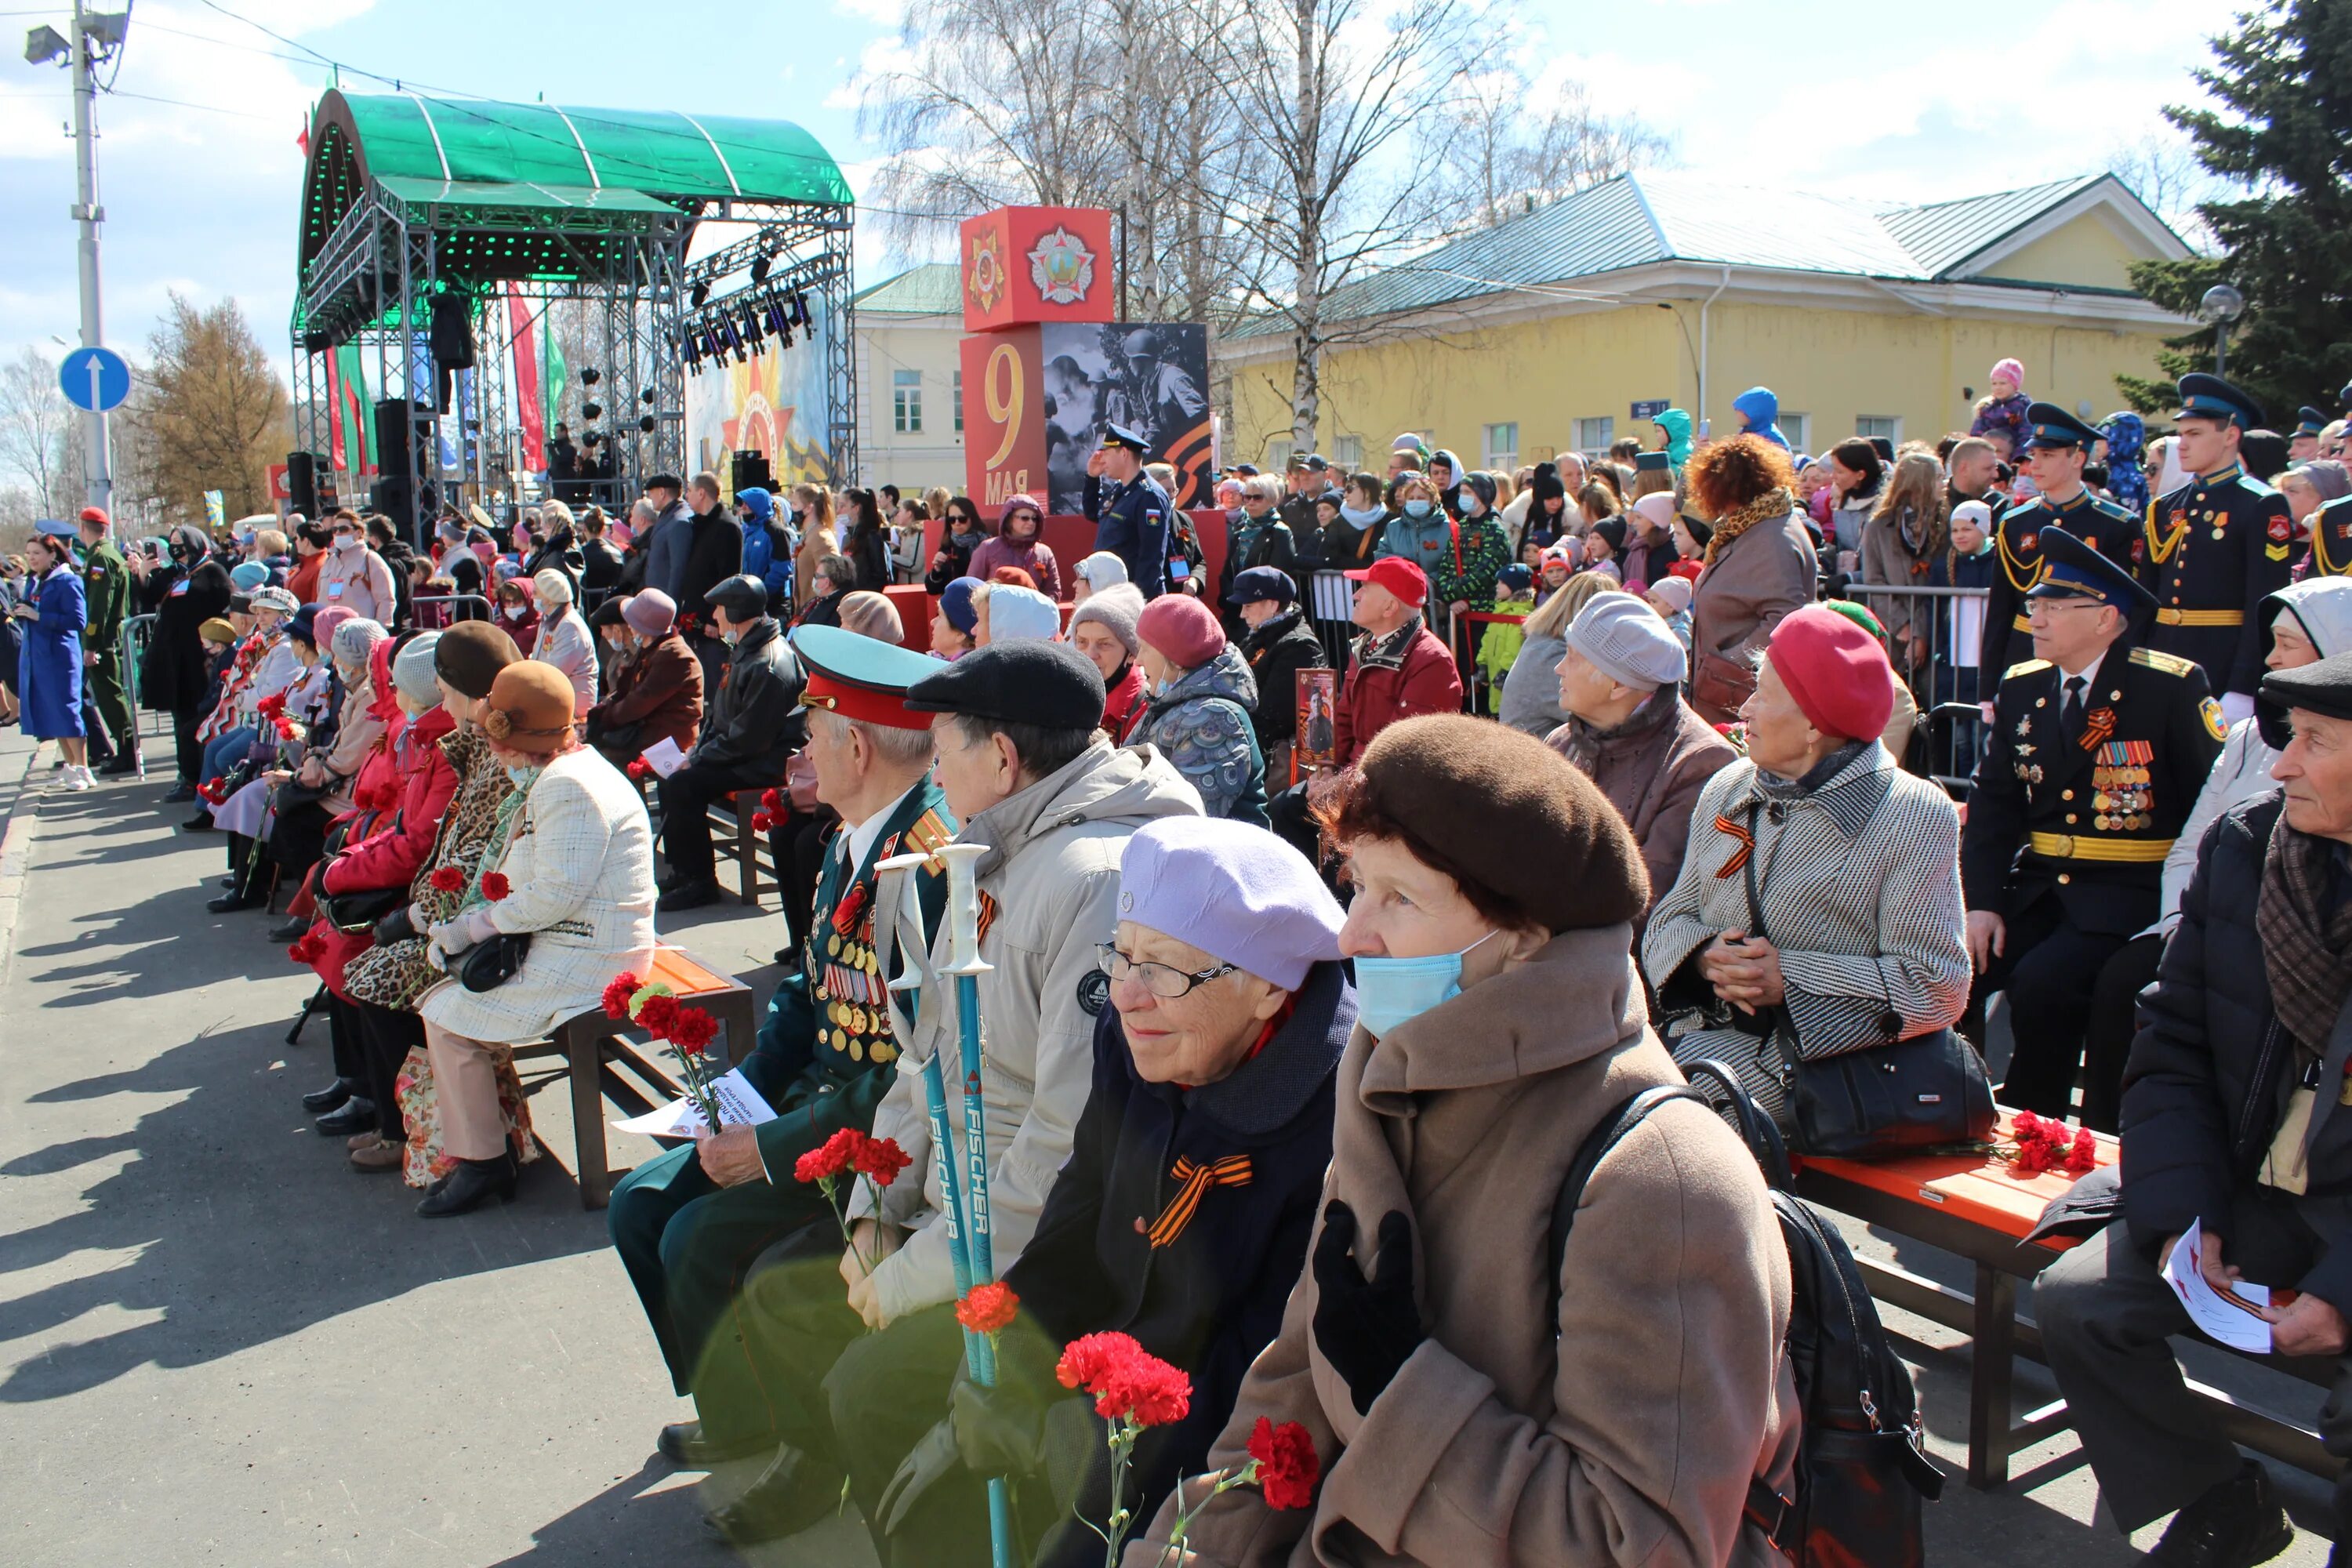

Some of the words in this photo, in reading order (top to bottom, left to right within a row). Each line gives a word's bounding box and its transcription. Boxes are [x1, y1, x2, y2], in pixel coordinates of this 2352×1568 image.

[984, 343, 1024, 470] 9
[985, 469, 1028, 506] МАЯ
[724, 1086, 753, 1118] НАРОДА-ГЕРОЯ
[731, 1105, 750, 1126] ЕЛИКИЙ
[930, 1116, 959, 1240] FISCHER
[967, 1108, 989, 1235] FISCHER
